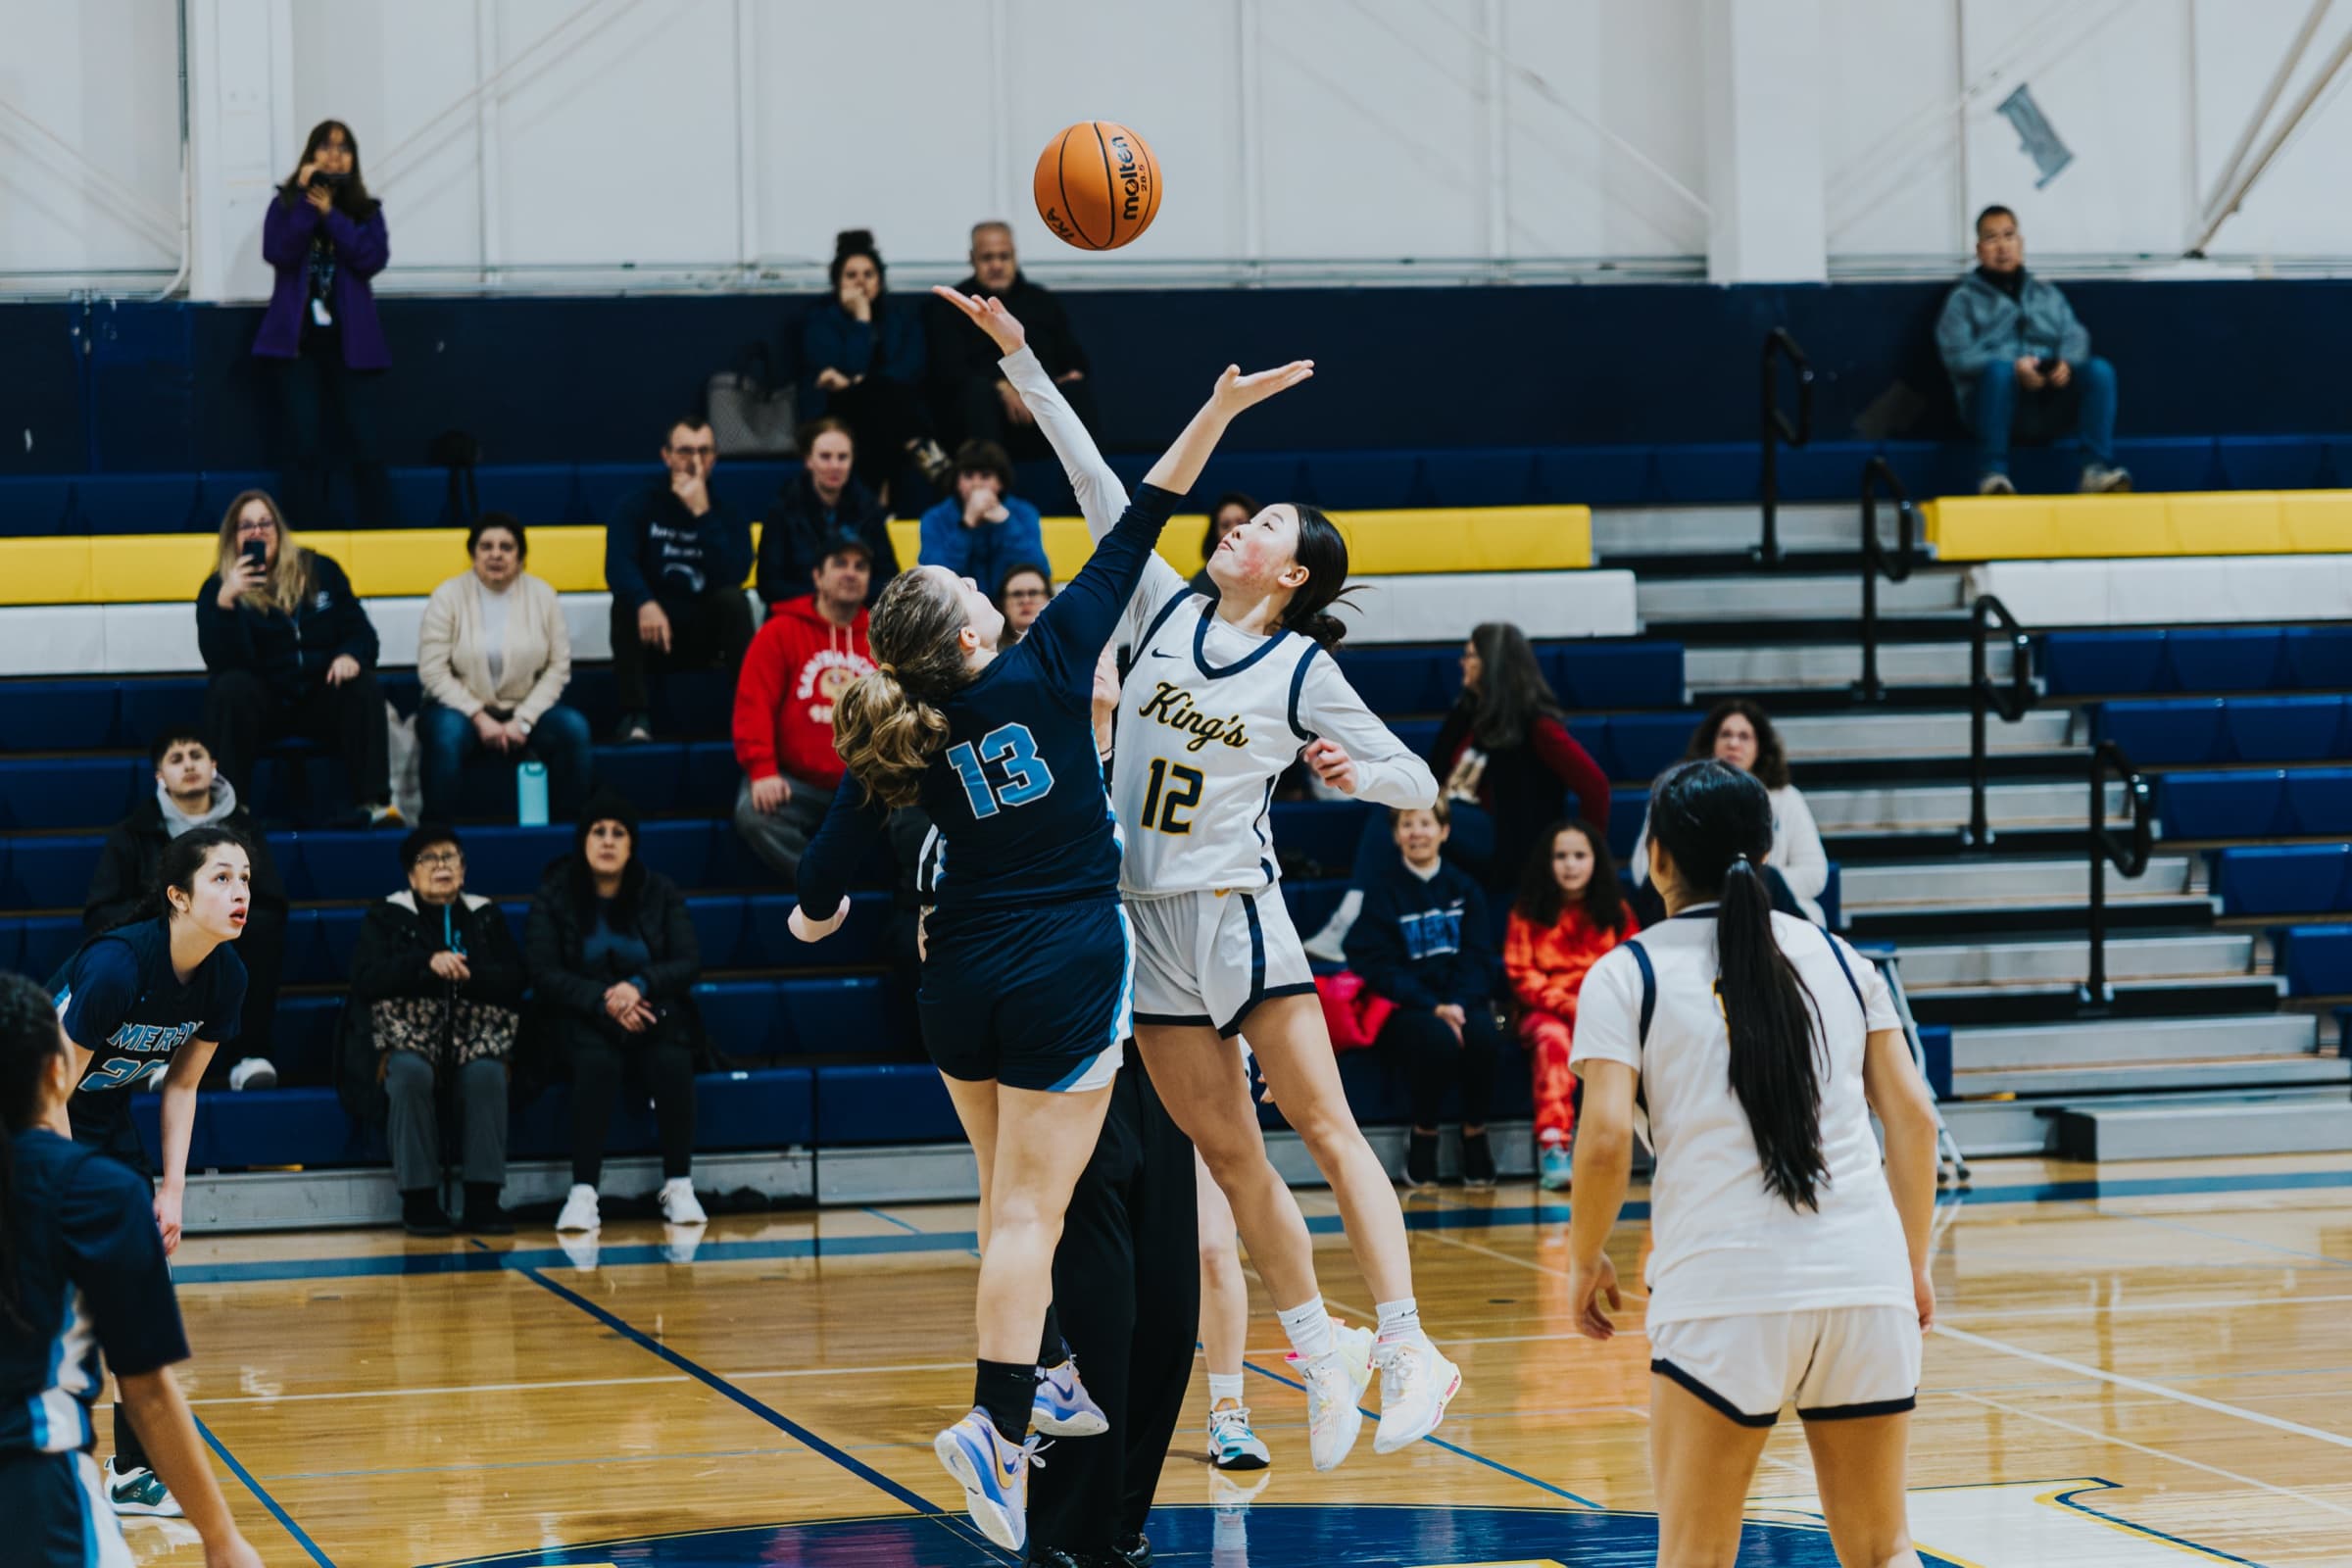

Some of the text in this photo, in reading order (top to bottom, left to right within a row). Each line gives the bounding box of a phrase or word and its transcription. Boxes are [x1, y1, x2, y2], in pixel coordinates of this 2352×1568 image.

[1111, 136, 1140, 220] molten
[1139, 164, 1148, 192] 28.5
[1138, 681, 1250, 752] King's
[946, 721, 1055, 820] 13
[1140, 756, 1206, 836] 12
